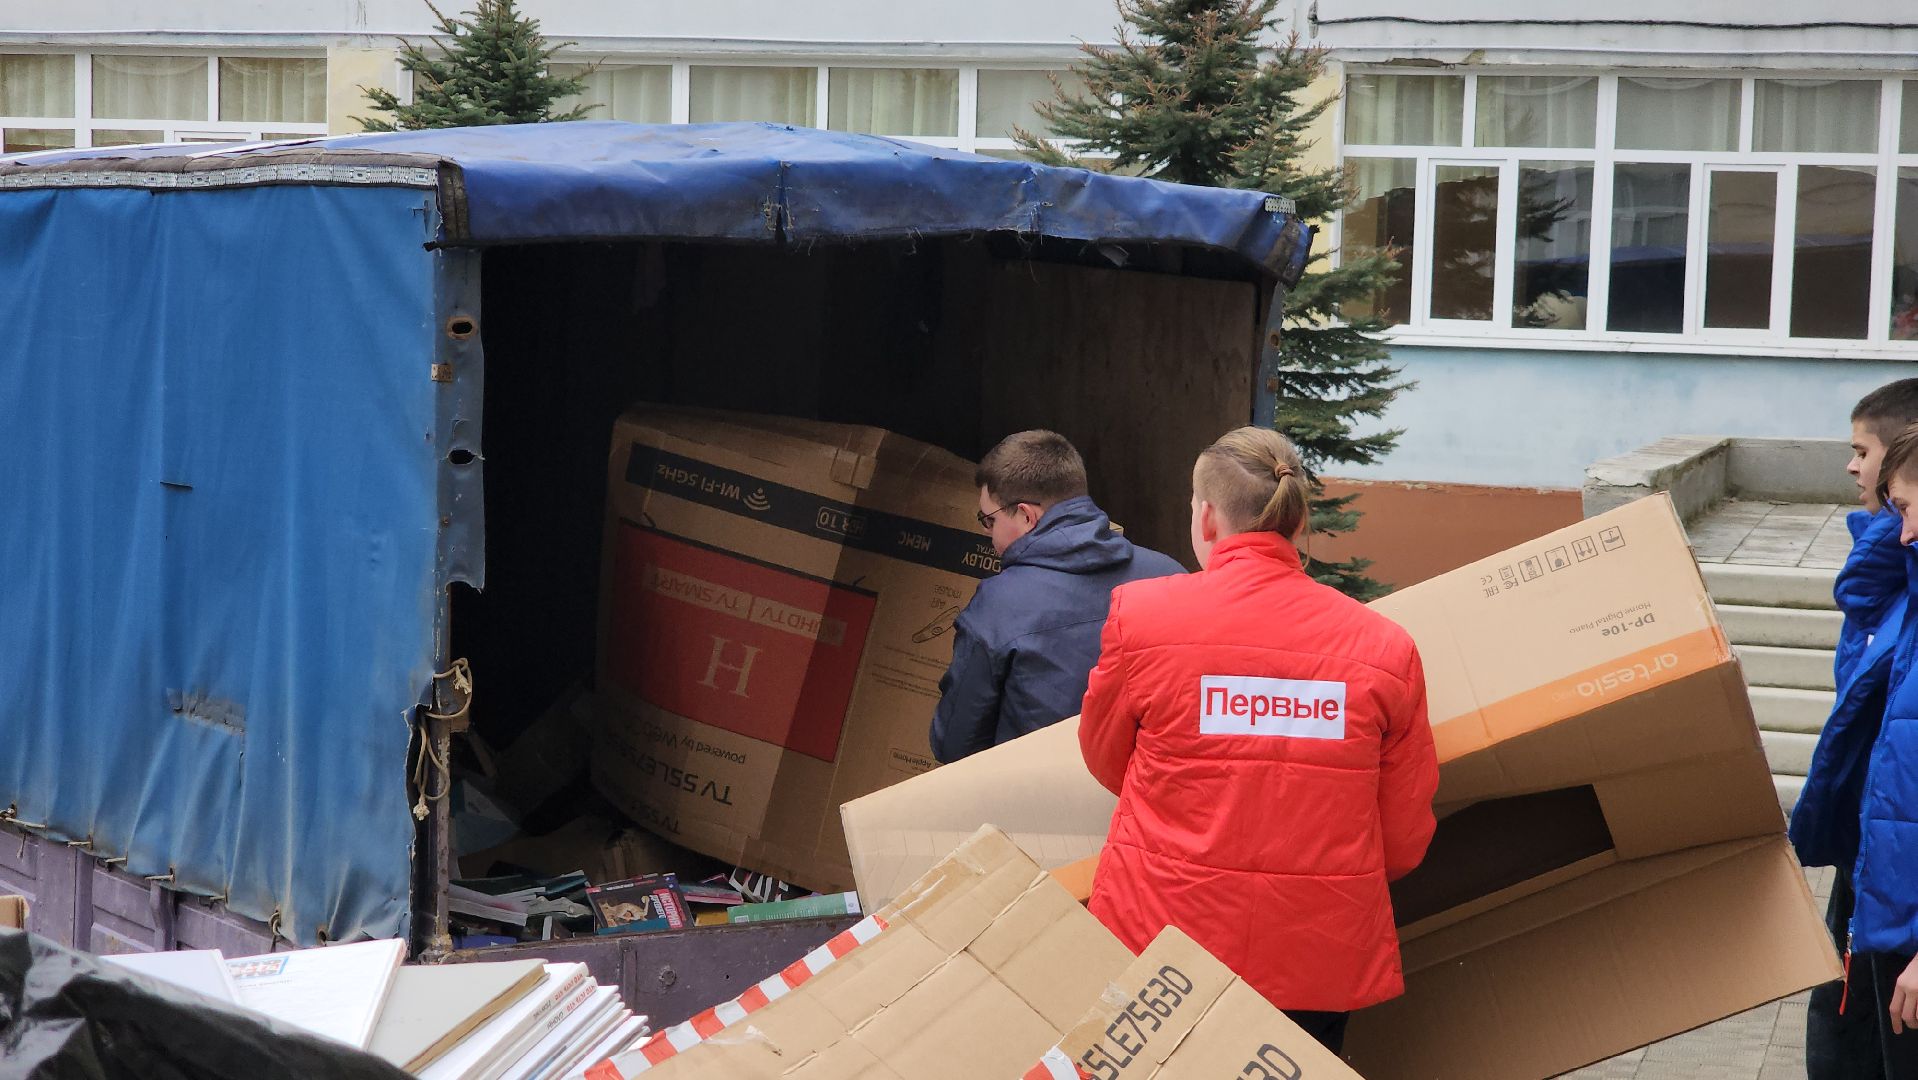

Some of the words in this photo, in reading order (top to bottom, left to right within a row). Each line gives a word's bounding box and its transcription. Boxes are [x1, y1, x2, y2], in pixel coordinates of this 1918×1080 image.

[656, 463, 697, 488] 5GHz
[819, 511, 838, 527] 10
[897, 531, 931, 552] MEMC
[961, 550, 1002, 573] DOLBY
[650, 572, 712, 602] SMART
[1595, 610, 1624, 630] Digital
[1624, 602, 1652, 616] Home
[1569, 620, 1595, 635] Piano
[1601, 611, 1656, 638] DP-10e
[697, 634, 763, 700] H
[1576, 652, 1678, 698] artesia
[1205, 687, 1339, 726] Первые
[680, 736, 695, 750] by
[695, 741, 746, 764] powered
[893, 752, 912, 764] Home
[911, 758, 932, 768] Apple
[700, 780, 733, 806] TV
